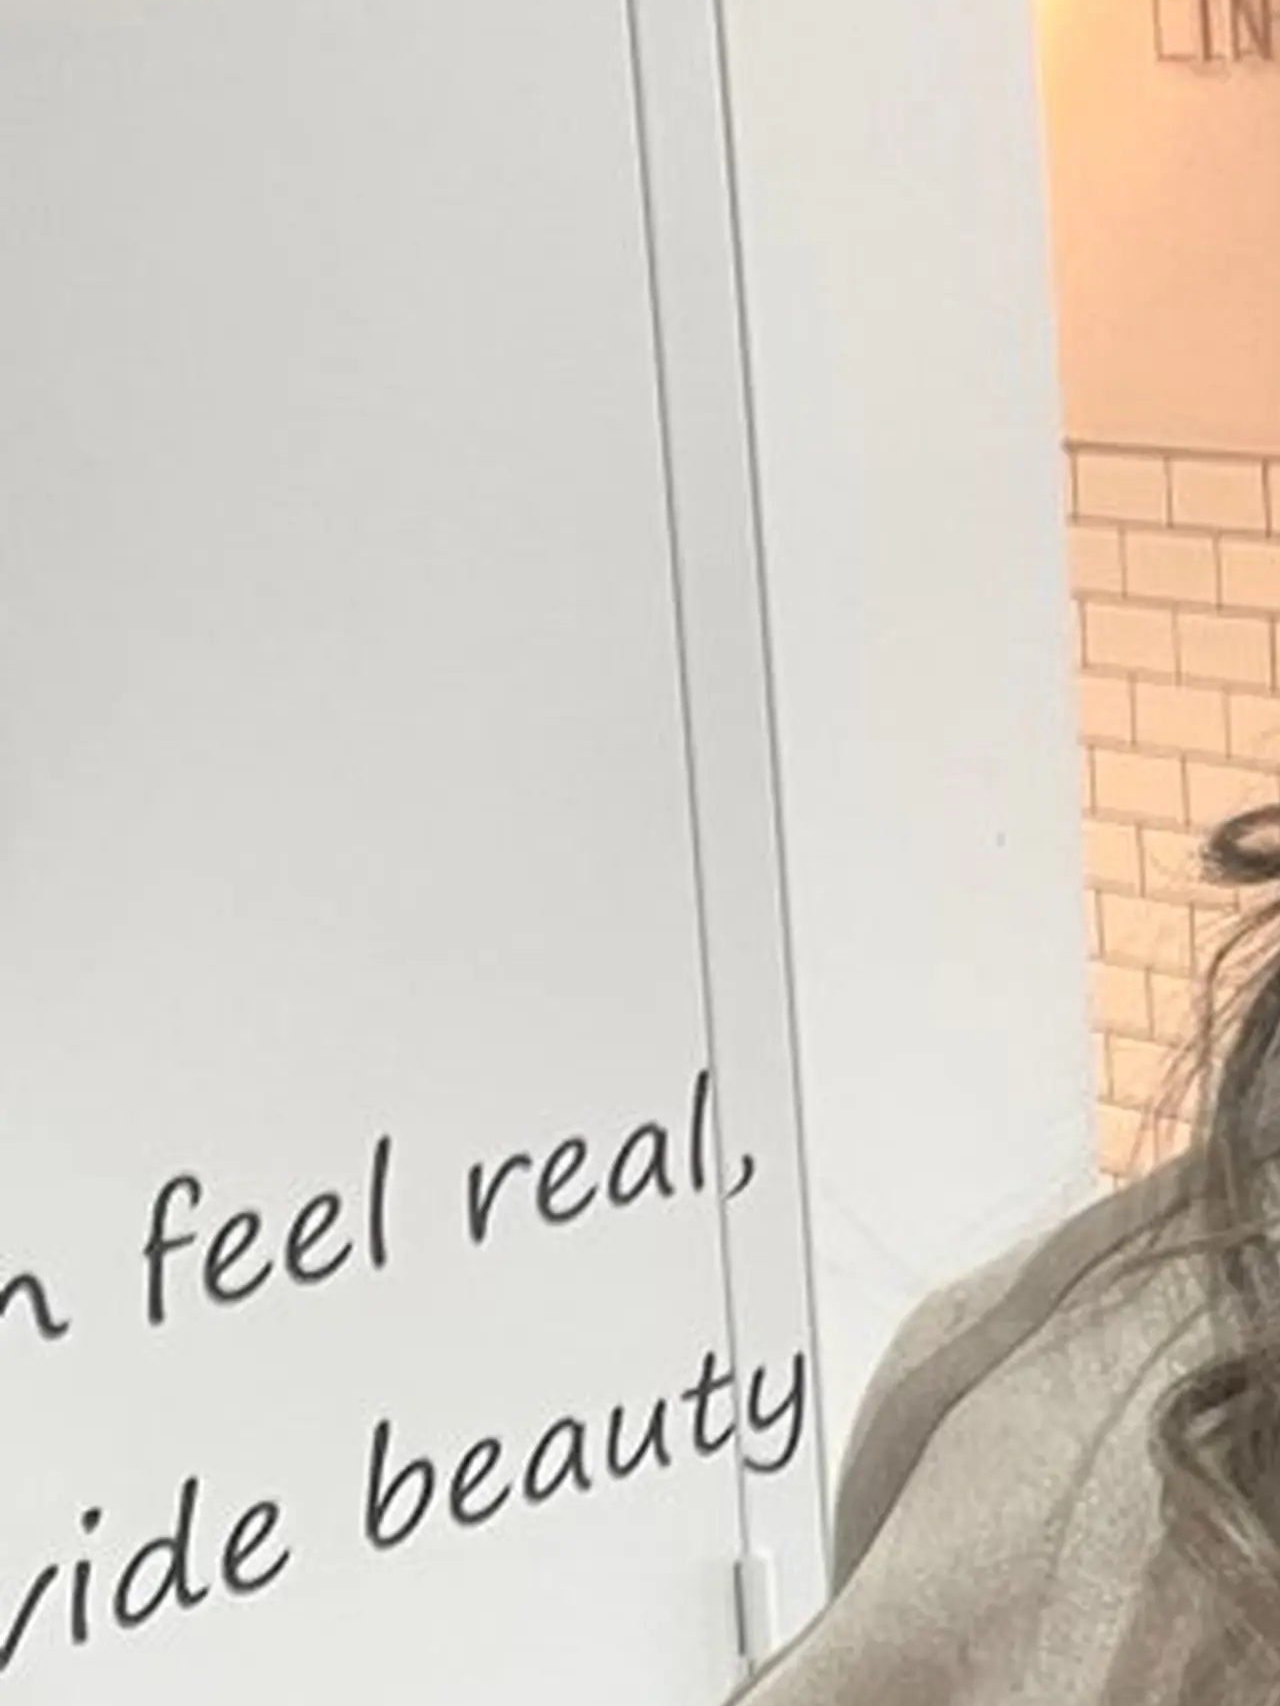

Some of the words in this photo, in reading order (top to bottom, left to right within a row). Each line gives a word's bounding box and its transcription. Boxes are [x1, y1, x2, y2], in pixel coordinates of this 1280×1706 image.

[143, 1136, 391, 1326] feel
[468, 1068, 755, 1244] real,
[365, 1348, 805, 1549] beauty
